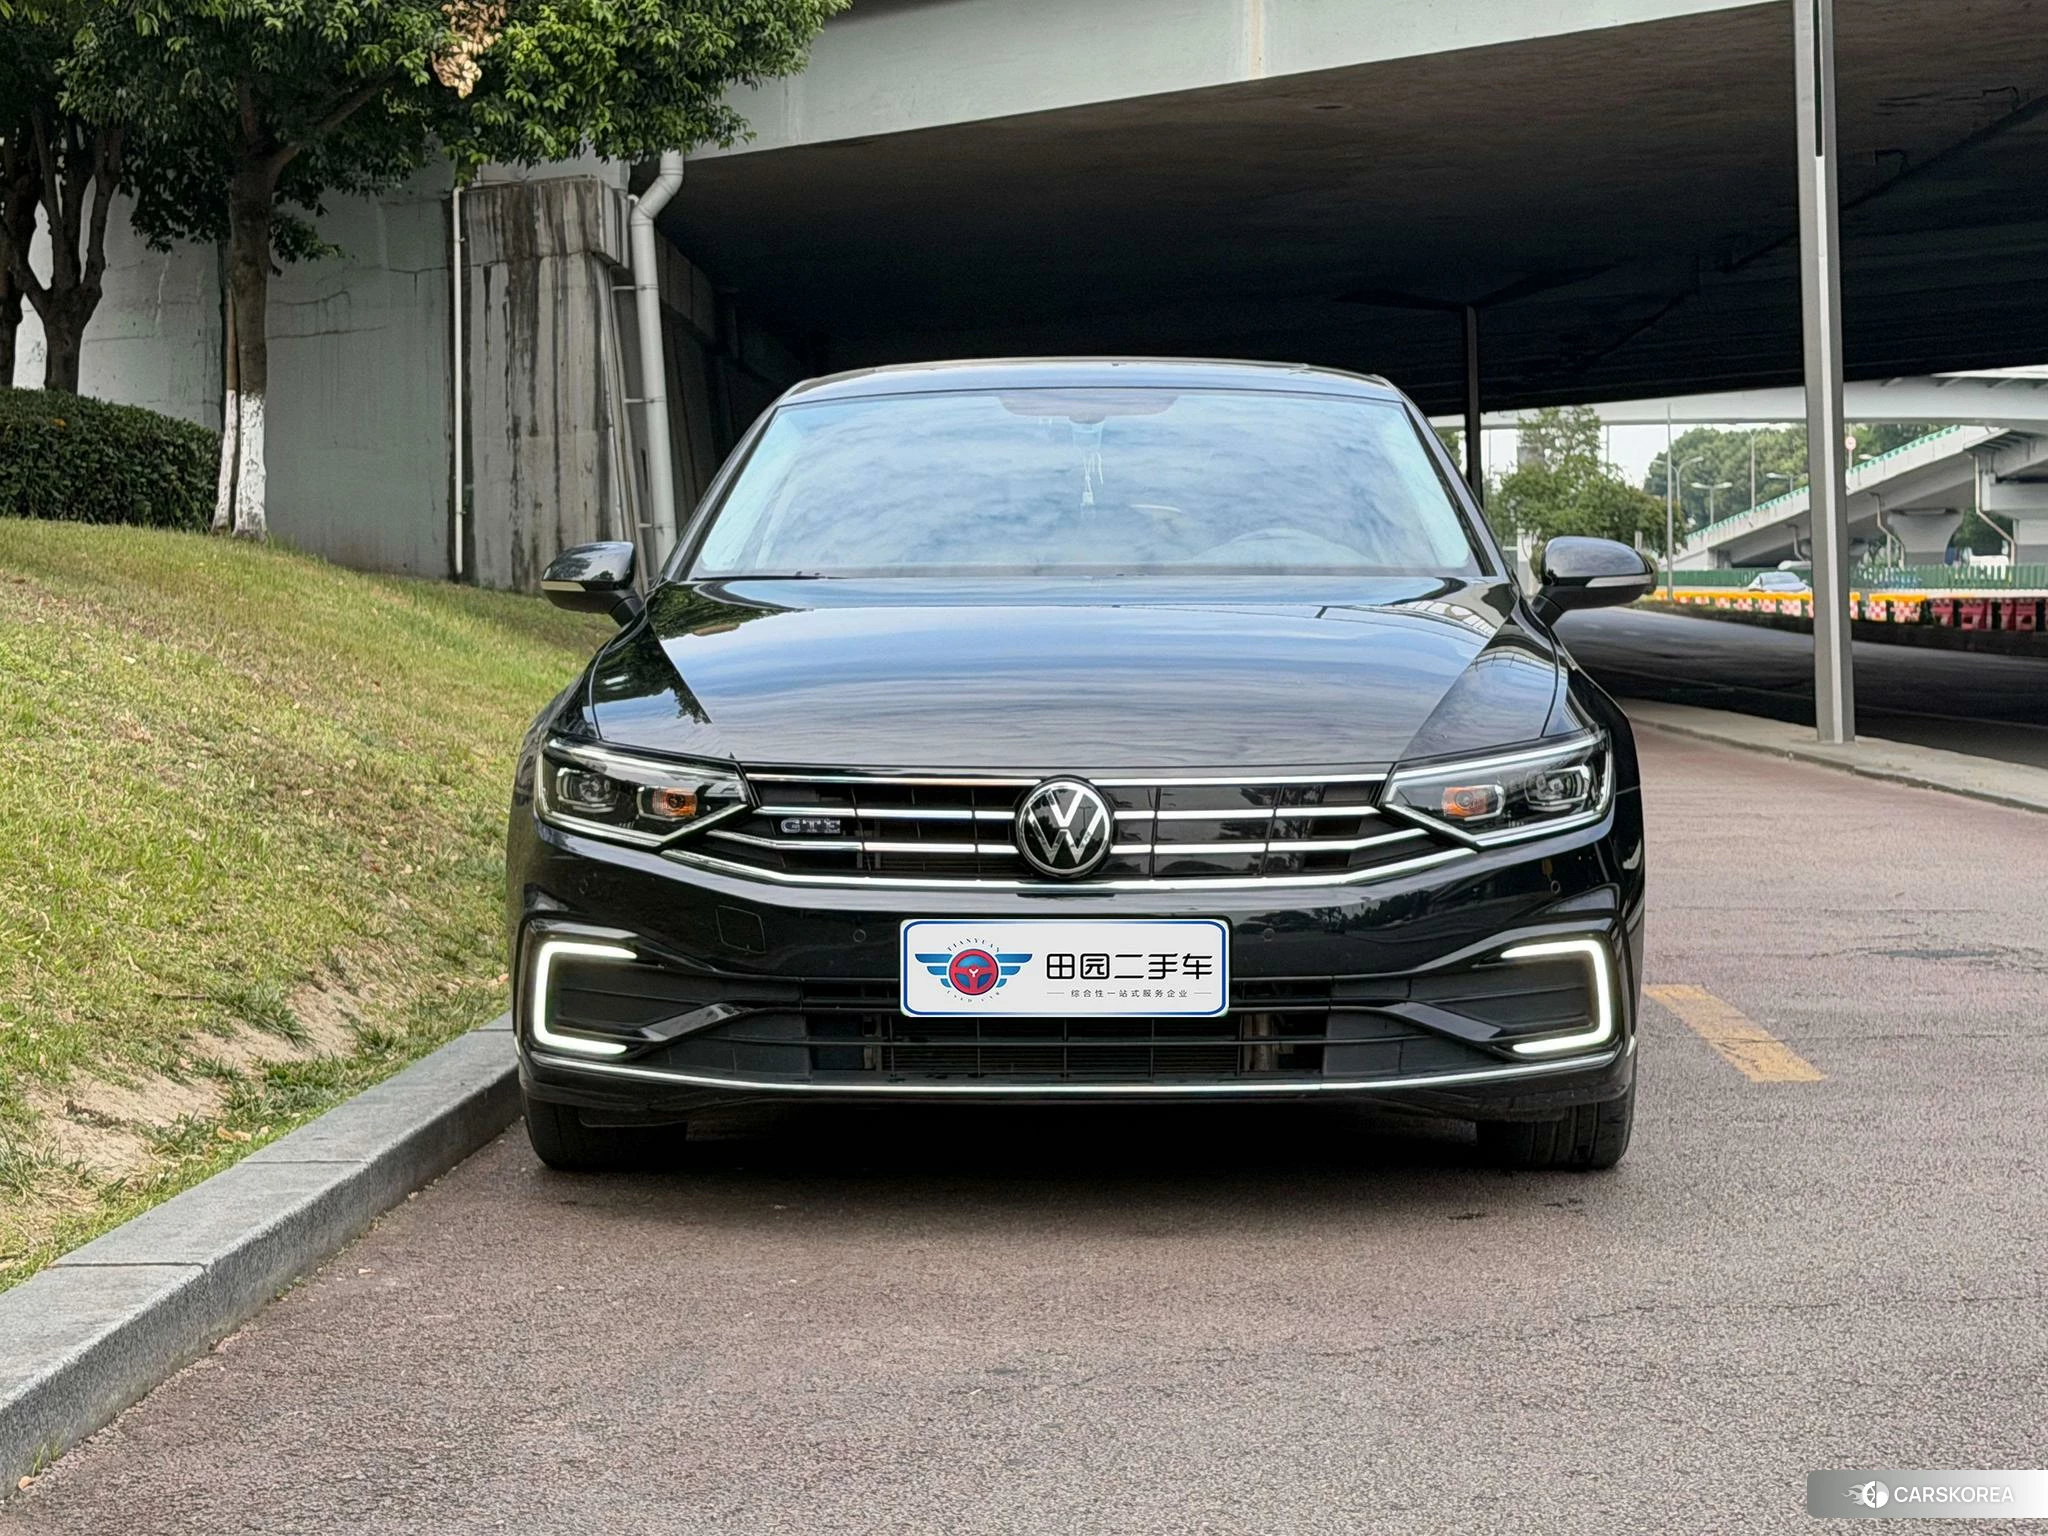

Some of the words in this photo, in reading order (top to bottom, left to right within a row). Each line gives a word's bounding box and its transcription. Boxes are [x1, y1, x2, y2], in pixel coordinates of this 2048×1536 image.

[780, 819, 841, 834] GTE
[1026, 787, 1103, 865] VW
[1046, 953, 1213, 980] 田园二手车
[1070, 989, 1188, 998] 综合性一站式服务企业
